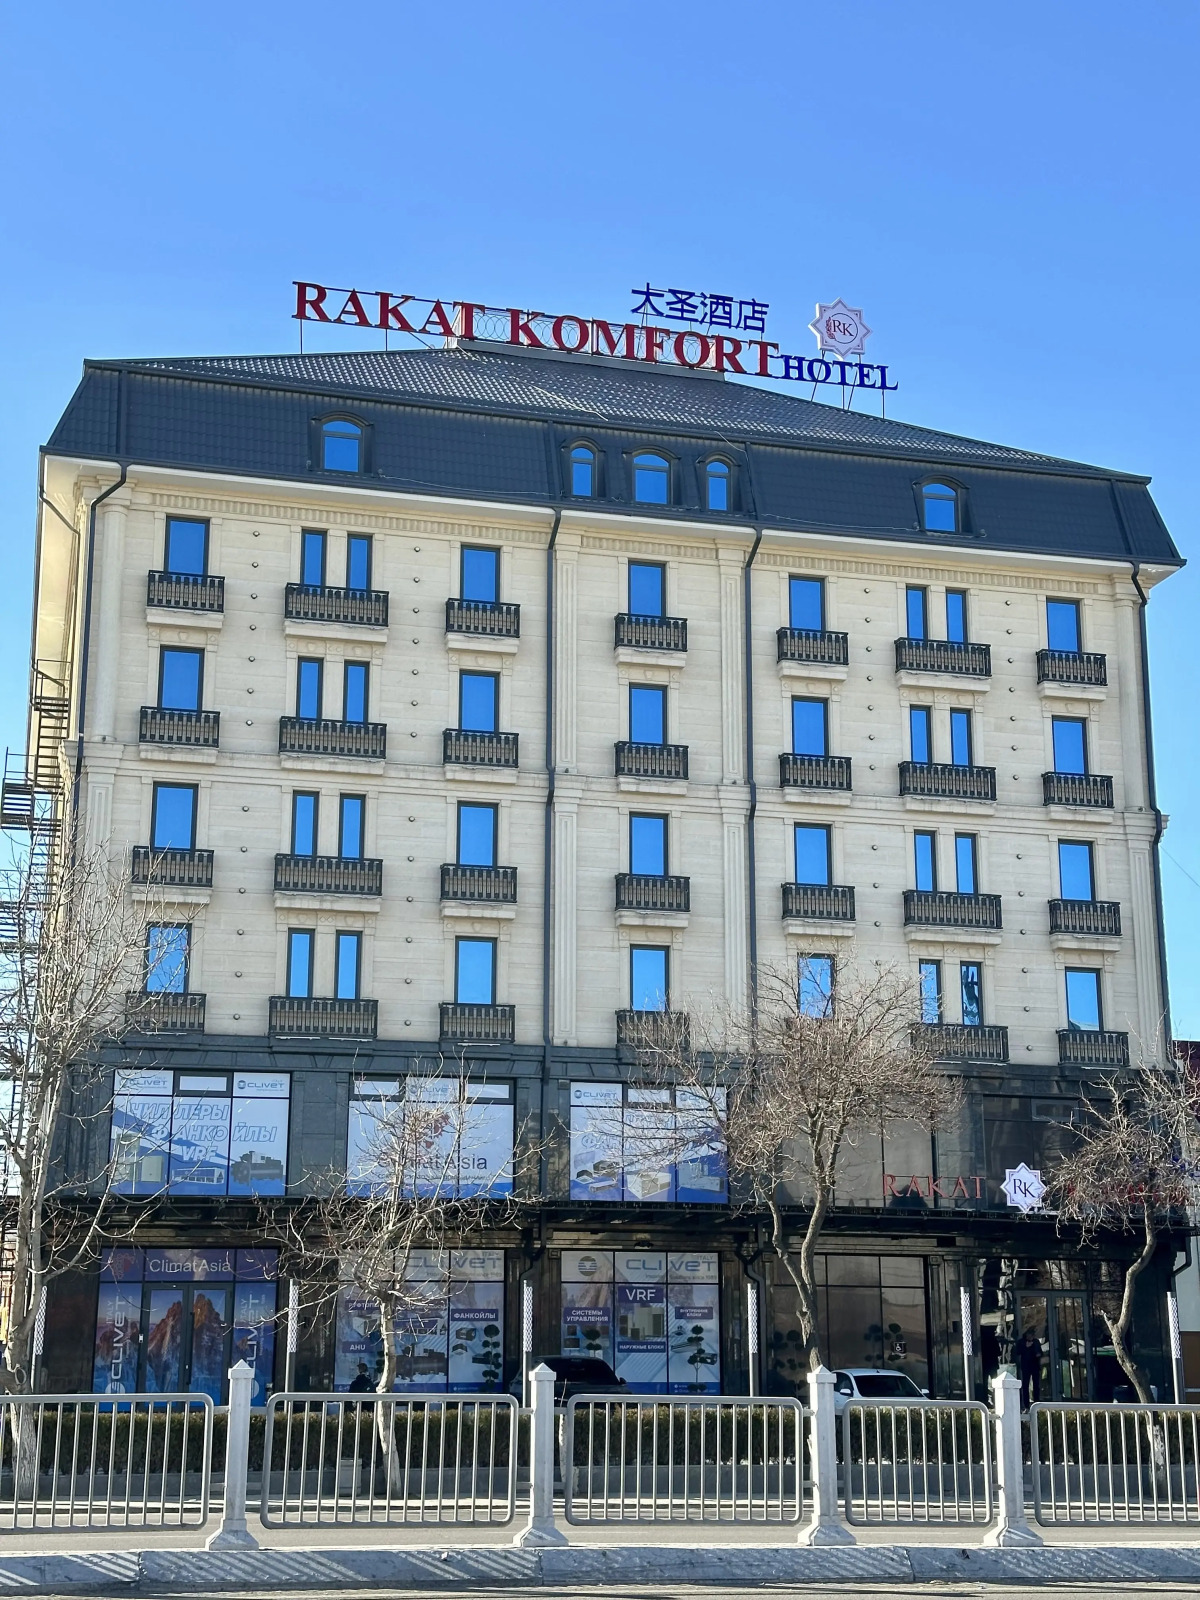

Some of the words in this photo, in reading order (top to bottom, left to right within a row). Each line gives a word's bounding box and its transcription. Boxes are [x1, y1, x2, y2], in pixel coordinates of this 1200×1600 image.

[631, 282, 770, 334] 大圣酒店
[291, 281, 486, 342] RAKAT
[505, 307, 780, 378] KOMFORT
[781, 354, 899, 391] HOTEL
[831, 319, 855, 337] RK
[181, 1145, 218, 1161] VRF
[883, 1173, 987, 1199] RAKAT
[1013, 1179, 1036, 1198] RK
[625, 1288, 656, 1301] VRF
[453, 1312, 496, 1320] ФАНКОЙЛЫ
